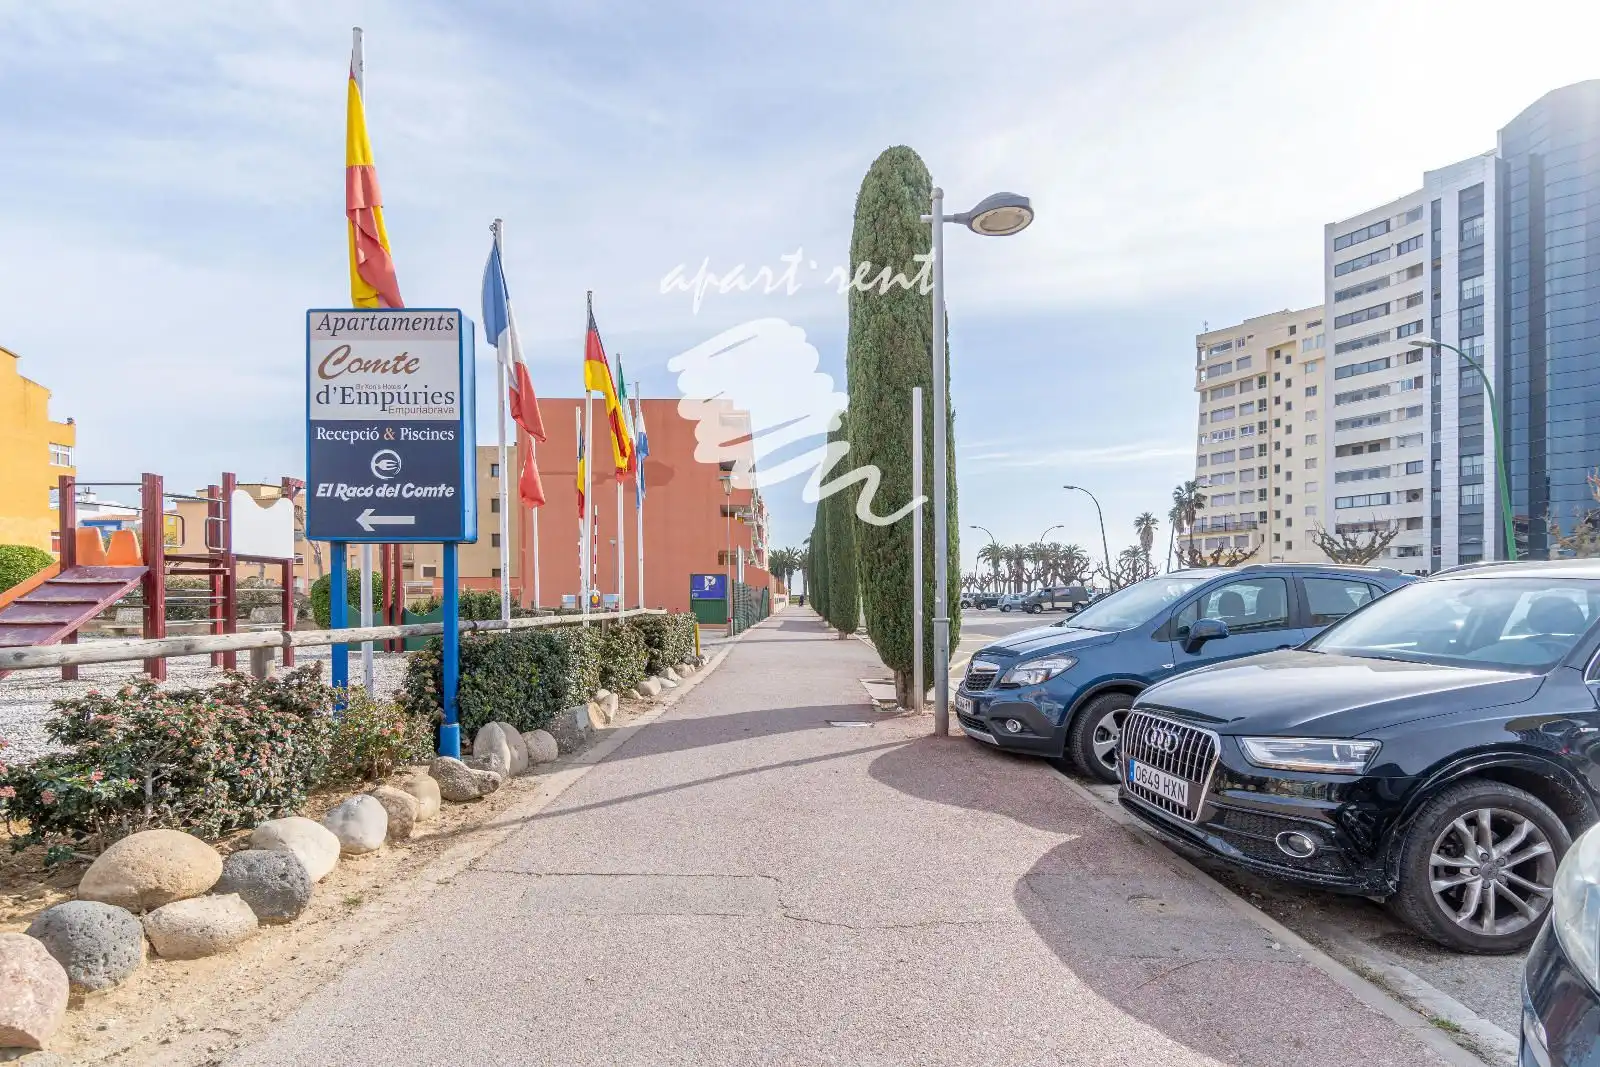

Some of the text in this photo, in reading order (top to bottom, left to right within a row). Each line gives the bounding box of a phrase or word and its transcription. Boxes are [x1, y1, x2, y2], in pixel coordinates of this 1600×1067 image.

[316, 313, 455, 336] Apartaments
[317, 344, 420, 380] Comte
[388, 405, 455, 416] Empuriabrava
[316, 427, 455, 444] Recepció & Piscines
[316, 483, 455, 501] El Racó del Comte
[704, 575, 716, 590] P
[1135, 765, 1185, 803] 0649 HXN
